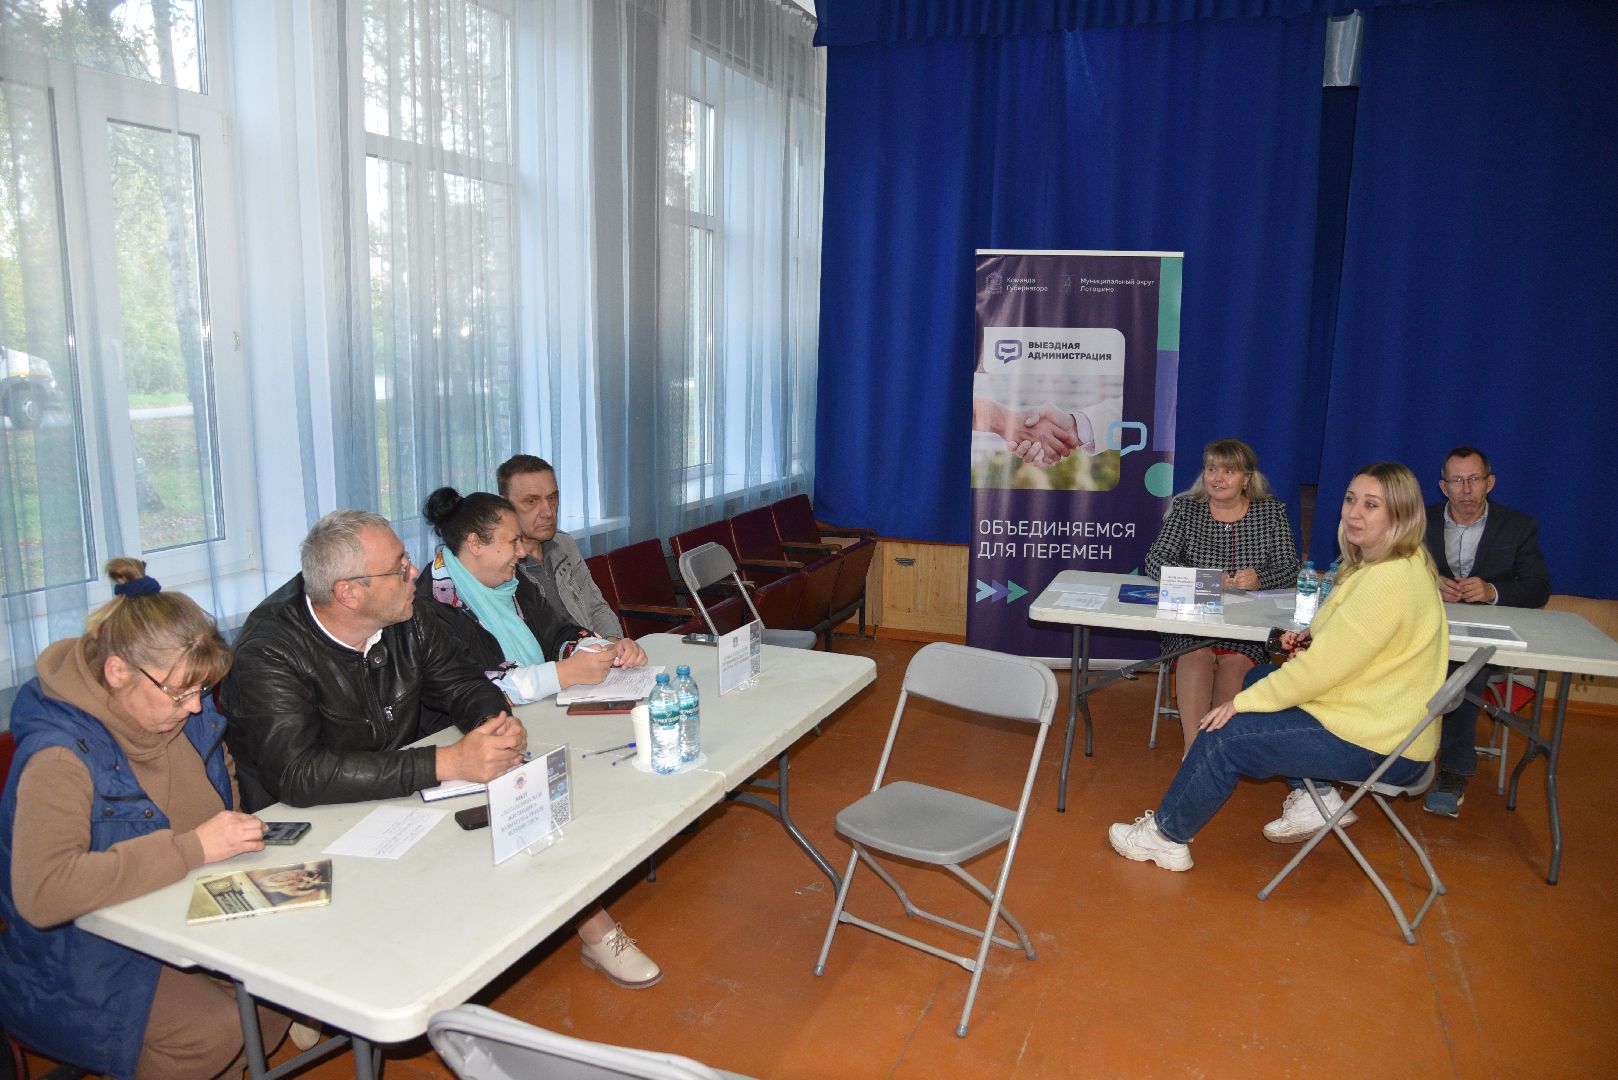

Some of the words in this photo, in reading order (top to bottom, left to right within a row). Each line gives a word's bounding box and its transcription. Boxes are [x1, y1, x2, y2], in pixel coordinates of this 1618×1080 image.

[1080, 278, 1135, 286] Муниципальный
[1136, 279, 1155, 287] округ
[1006, 285, 1049, 293] Губернатора
[1028, 341, 1081, 350] ВЫЕЗДНАЯ
[1027, 351, 1112, 362] АДМИНИСТРАЦИЯ
[978, 519, 1136, 538] ОБЪЕДИНЯЕМСЯ
[977, 541, 1016, 559] ДЛЯ
[1023, 543, 1112, 560] ПЕРЕМЕН
